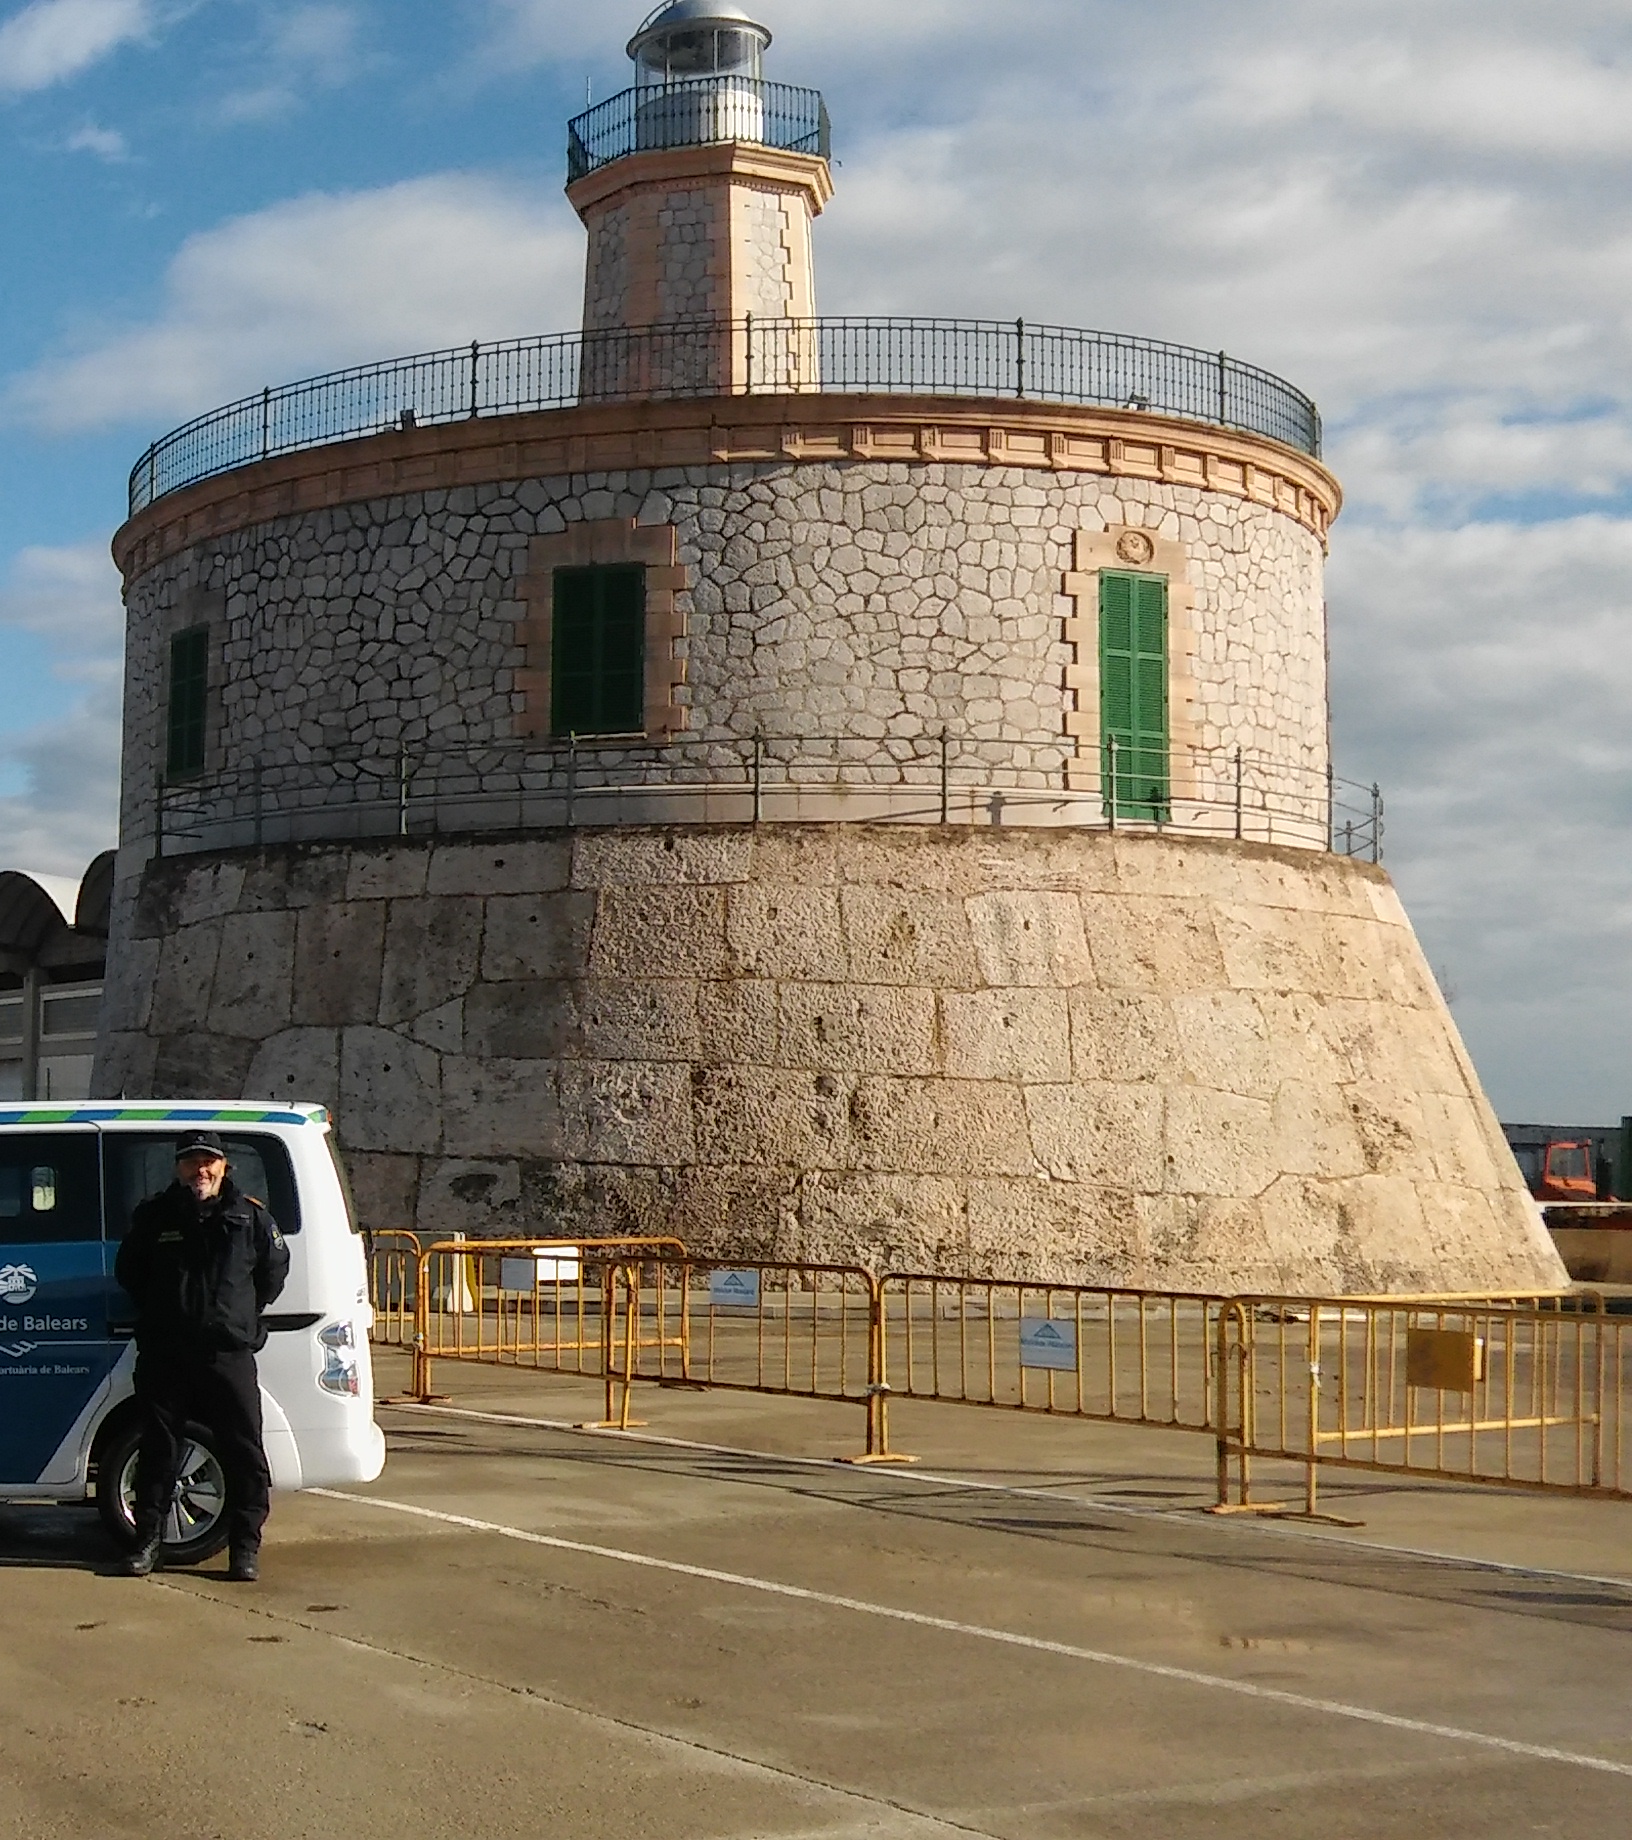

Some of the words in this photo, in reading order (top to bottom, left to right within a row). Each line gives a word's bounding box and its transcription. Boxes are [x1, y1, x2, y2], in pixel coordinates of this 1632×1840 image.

[23, 1315, 88, 1331] Balears
[40, 1365, 52, 1375] de
[54, 1364, 90, 1374] Balears
